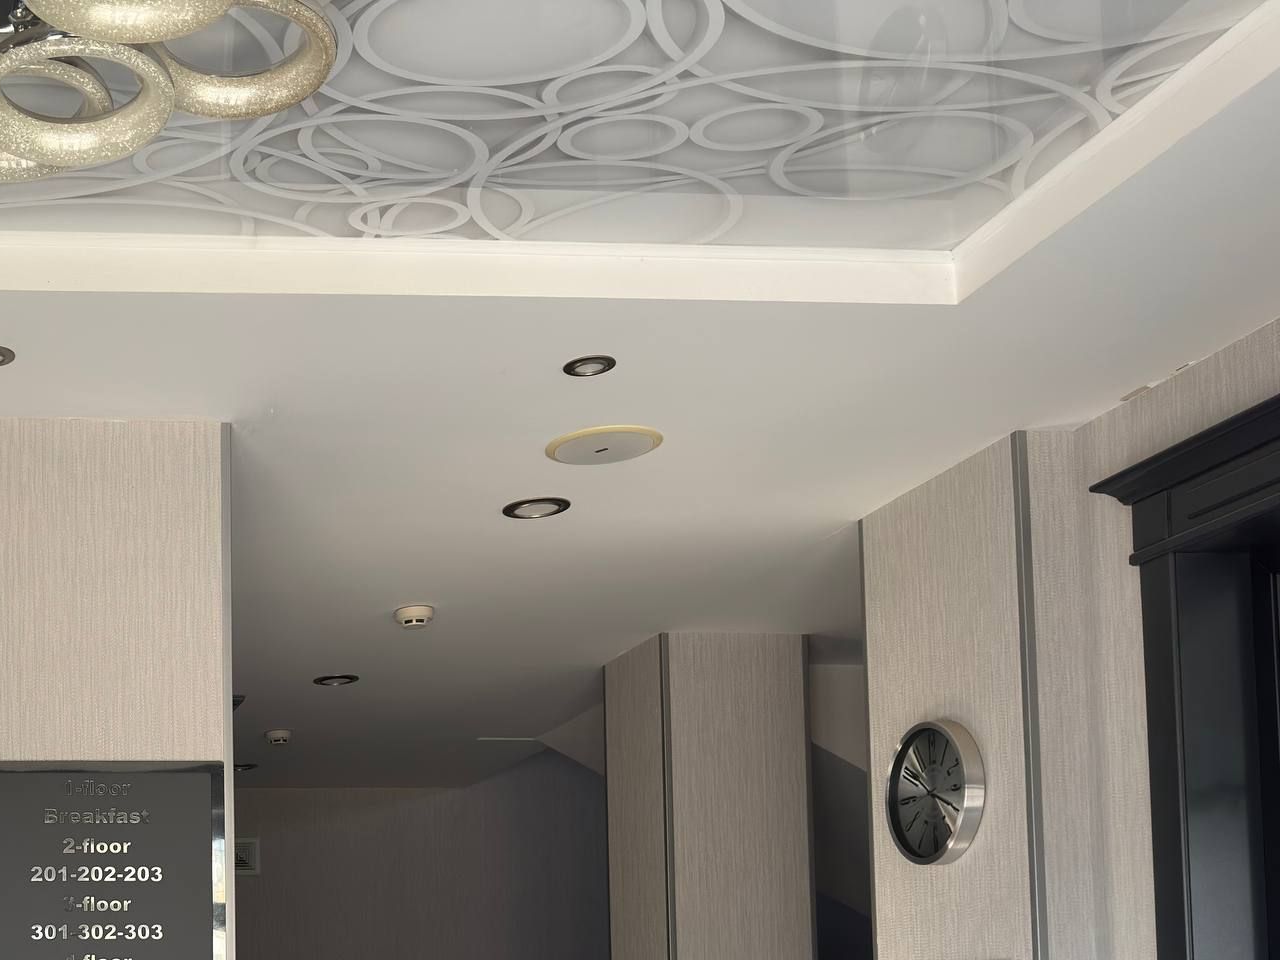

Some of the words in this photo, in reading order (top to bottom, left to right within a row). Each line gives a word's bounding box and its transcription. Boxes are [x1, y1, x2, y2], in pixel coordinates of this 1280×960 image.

[44, 807, 150, 824] Breakfast
[62, 837, 131, 853] 2-floor
[30, 866, 163, 882] 201-202-203
[31, 924, 164, 940] 301-302-303
